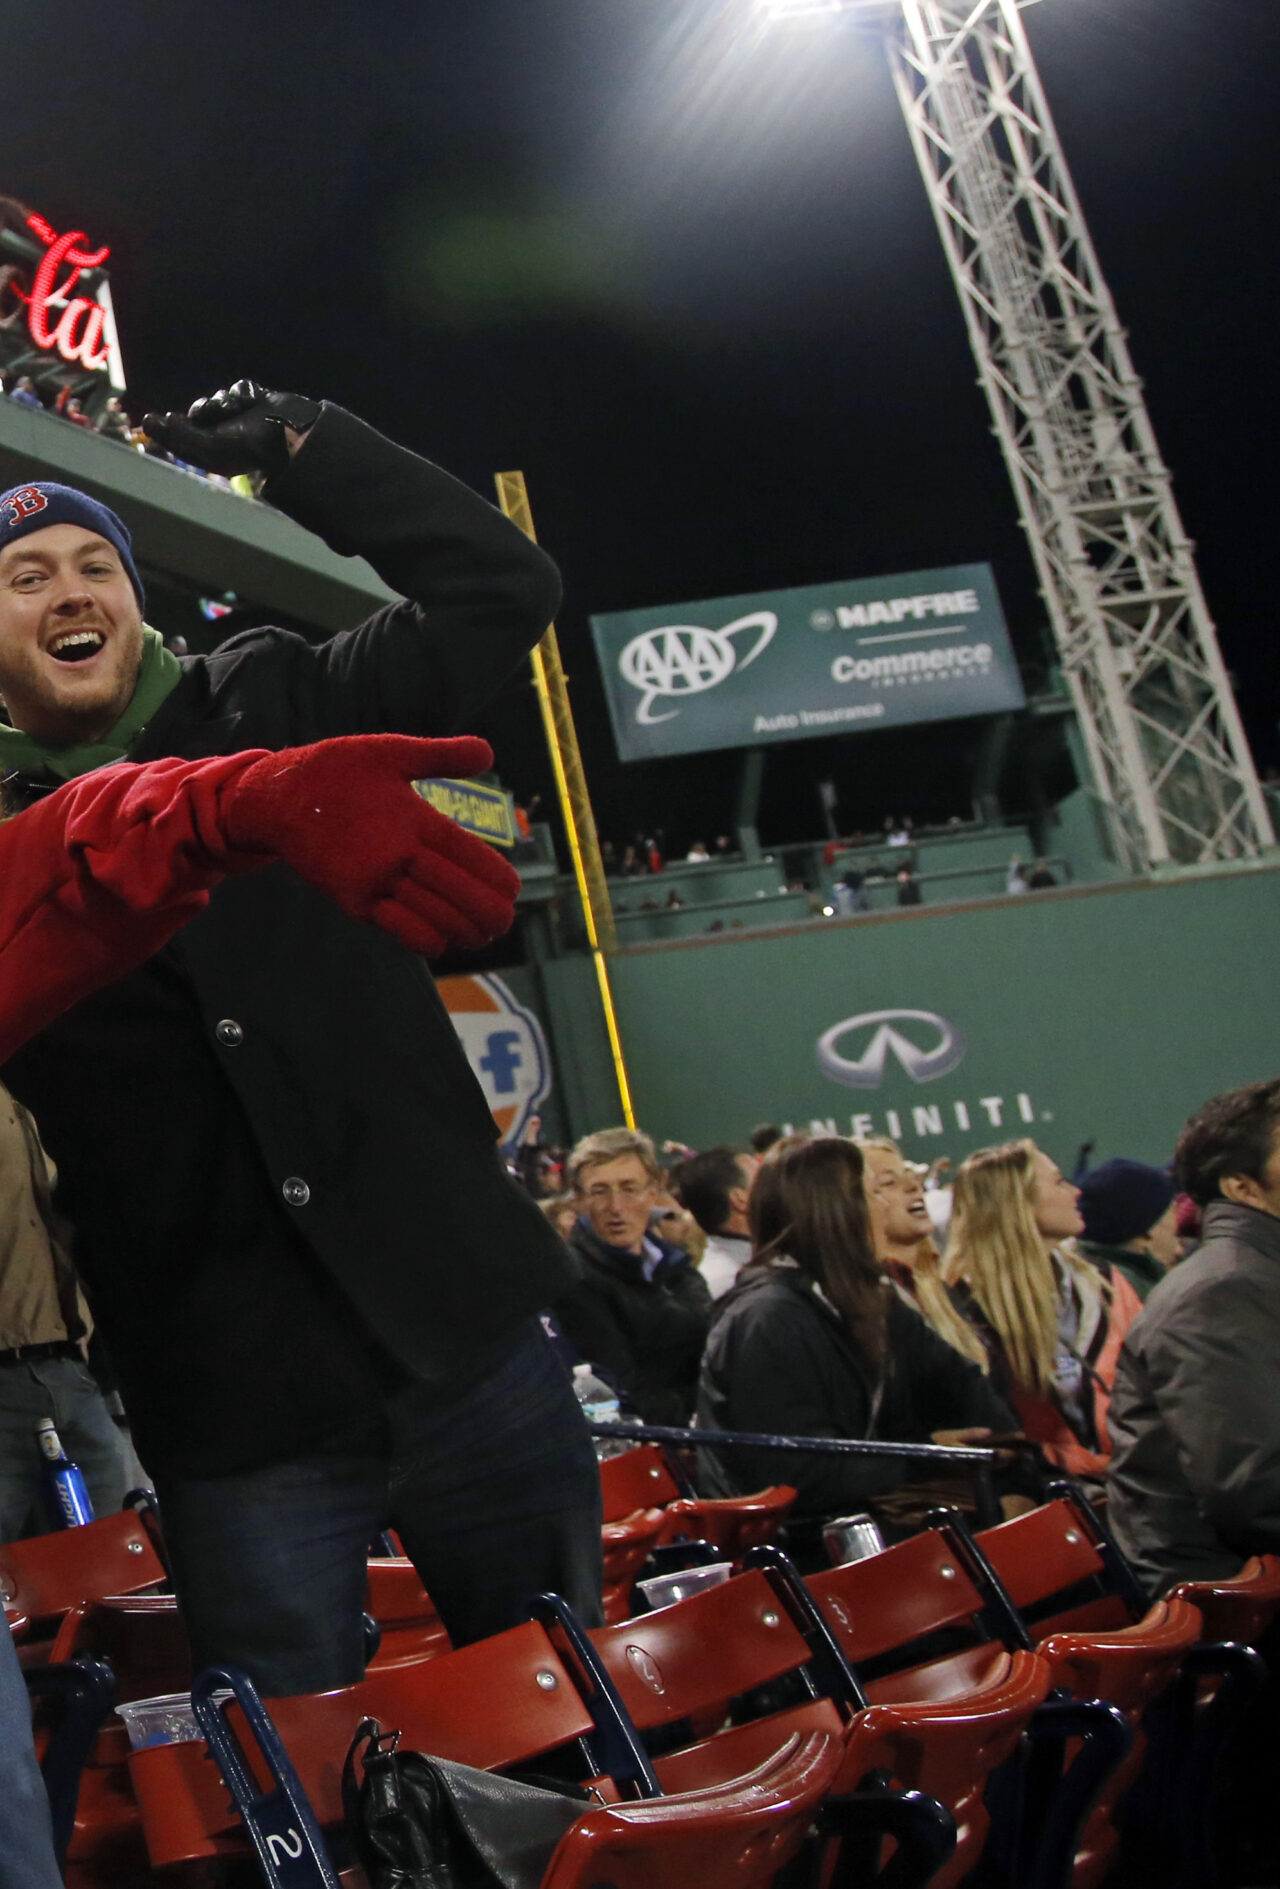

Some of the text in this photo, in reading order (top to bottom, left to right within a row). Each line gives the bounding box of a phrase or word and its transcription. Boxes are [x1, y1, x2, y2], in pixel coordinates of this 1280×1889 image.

[0, 486, 49, 526] B
[836, 588, 981, 629] MAPFRE
[625, 627, 728, 693] AAA
[831, 643, 993, 684] Commerce
[753, 702, 885, 733] Auto Insurance
[266, 1828, 303, 1866] 2
